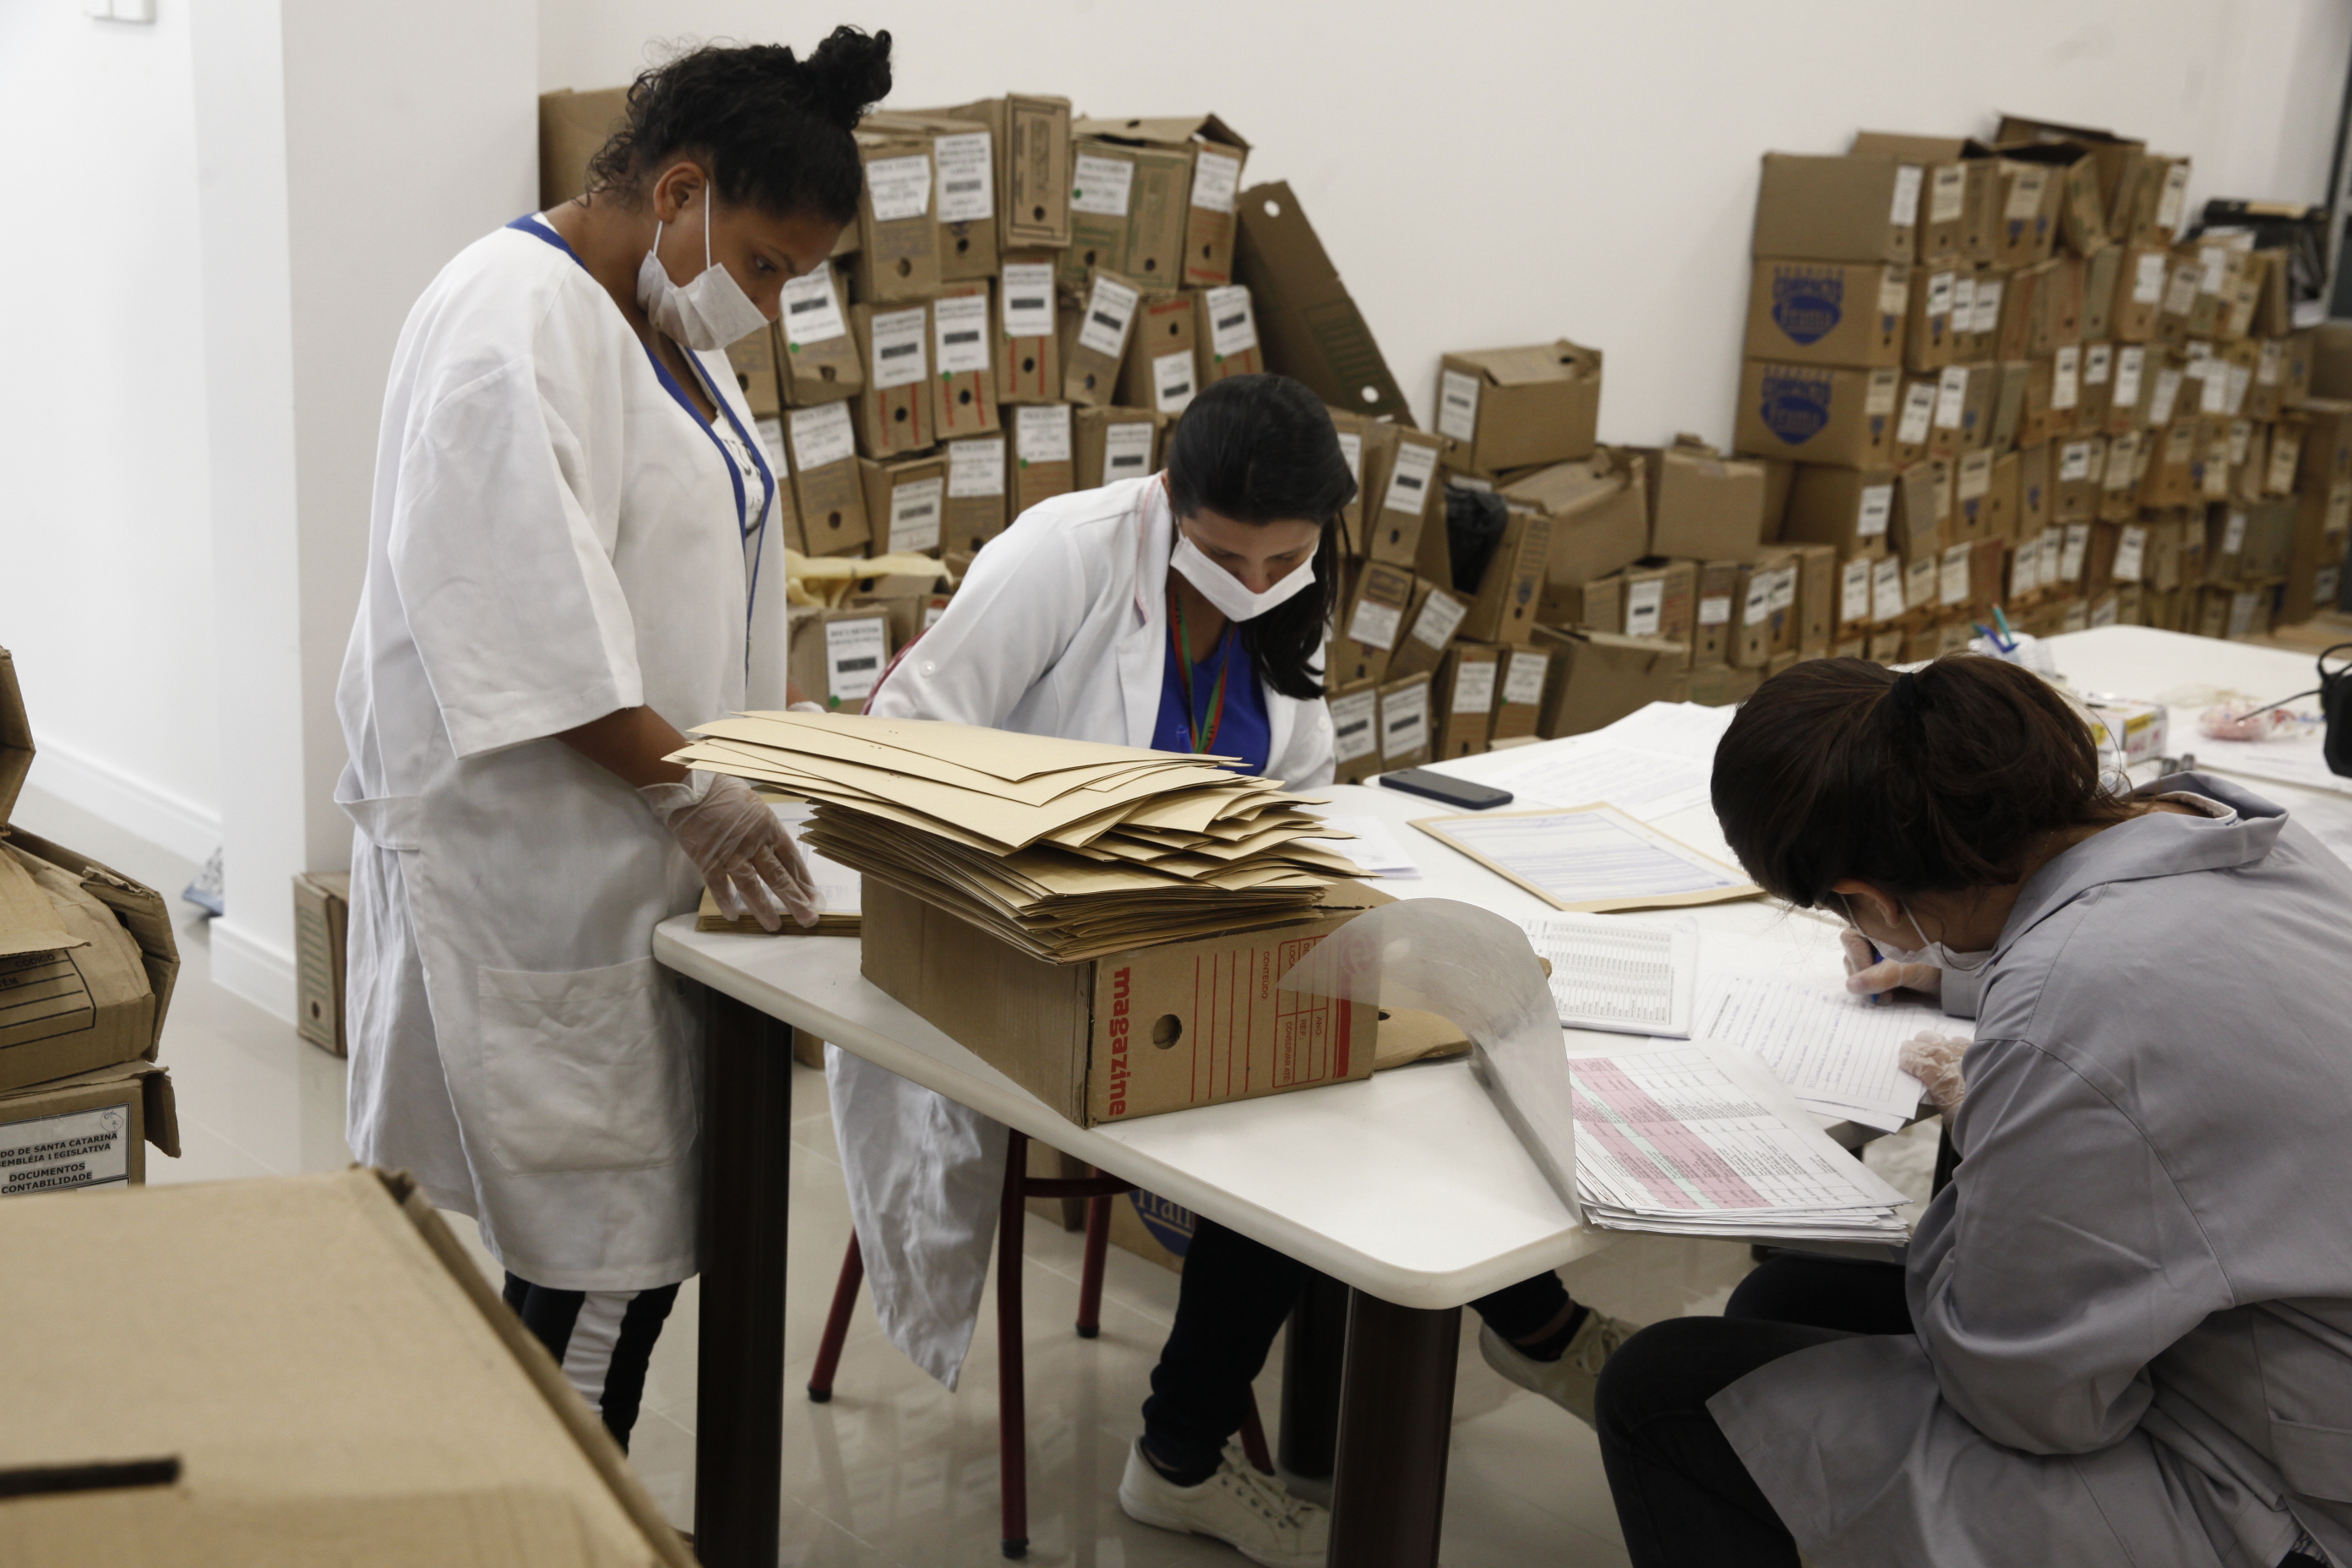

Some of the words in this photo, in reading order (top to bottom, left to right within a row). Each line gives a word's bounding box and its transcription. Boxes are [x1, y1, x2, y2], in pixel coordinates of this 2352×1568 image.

[16, 954, 56, 968] CÓDIGO
[1108, 966, 1131, 1116] magazine
[1284, 1021, 1293, 1065] CONSERVAR
[0, 1150, 14, 1158] DO
[34, 1141, 66, 1153] SANTA
[69, 1133, 117, 1147] CATARINA
[0, 1154, 45, 1167] EMBLÉIA
[2, 1172, 92, 1194] CONTABILIDADE
[9, 1162, 85, 1182] DOCUMENTOS
